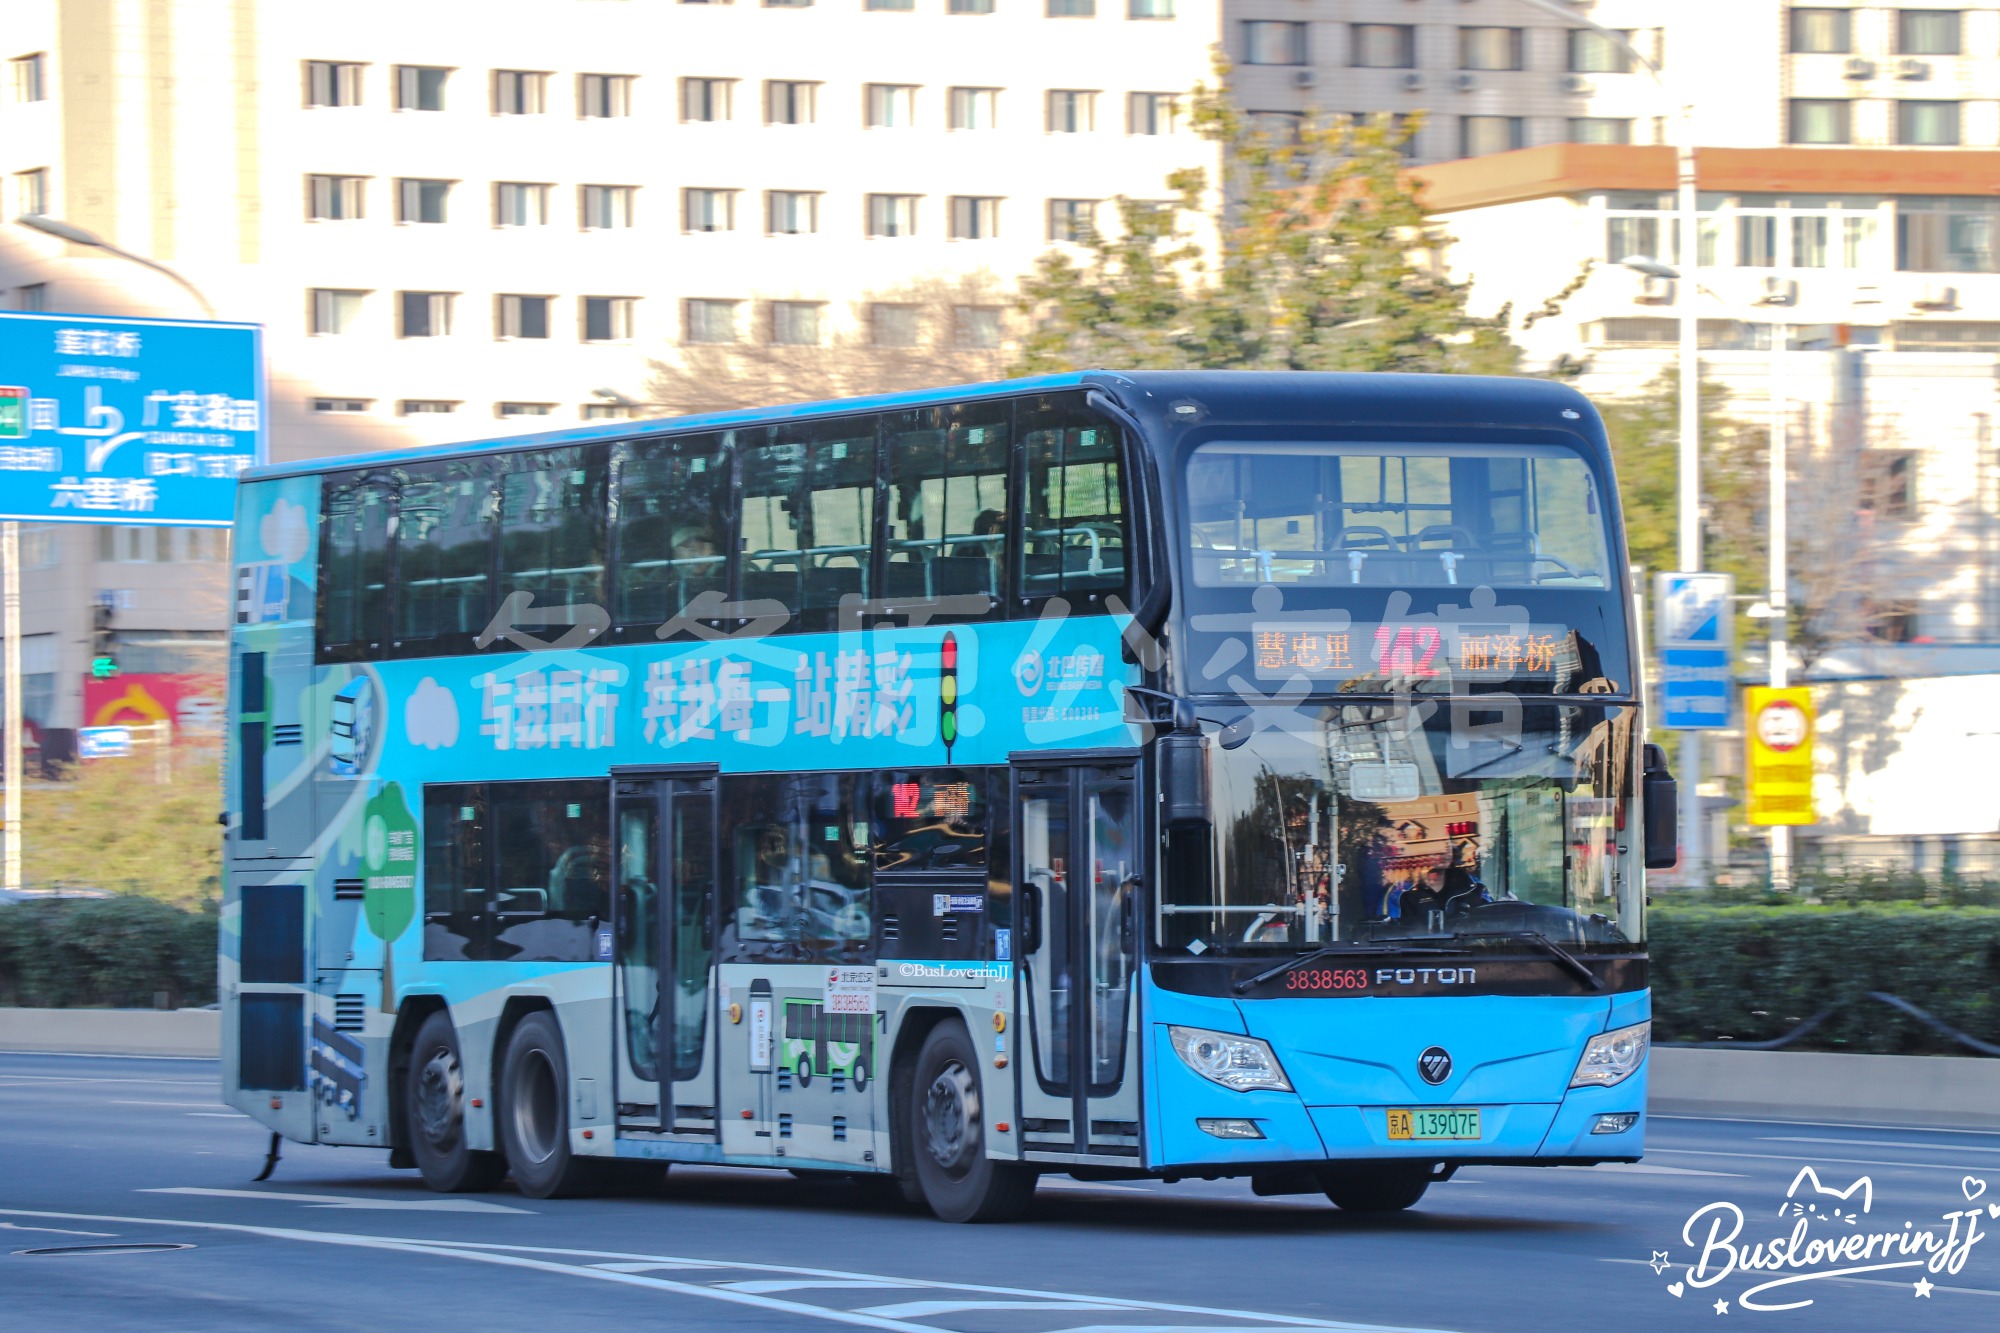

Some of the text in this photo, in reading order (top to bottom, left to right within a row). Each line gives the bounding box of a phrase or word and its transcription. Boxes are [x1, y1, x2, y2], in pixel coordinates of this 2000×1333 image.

[1256, 626, 1555, 676] 慧忠里 142 丽泽桥
[1286, 969, 1368, 990] 3838563
[1376, 967, 1476, 985] FOTON
